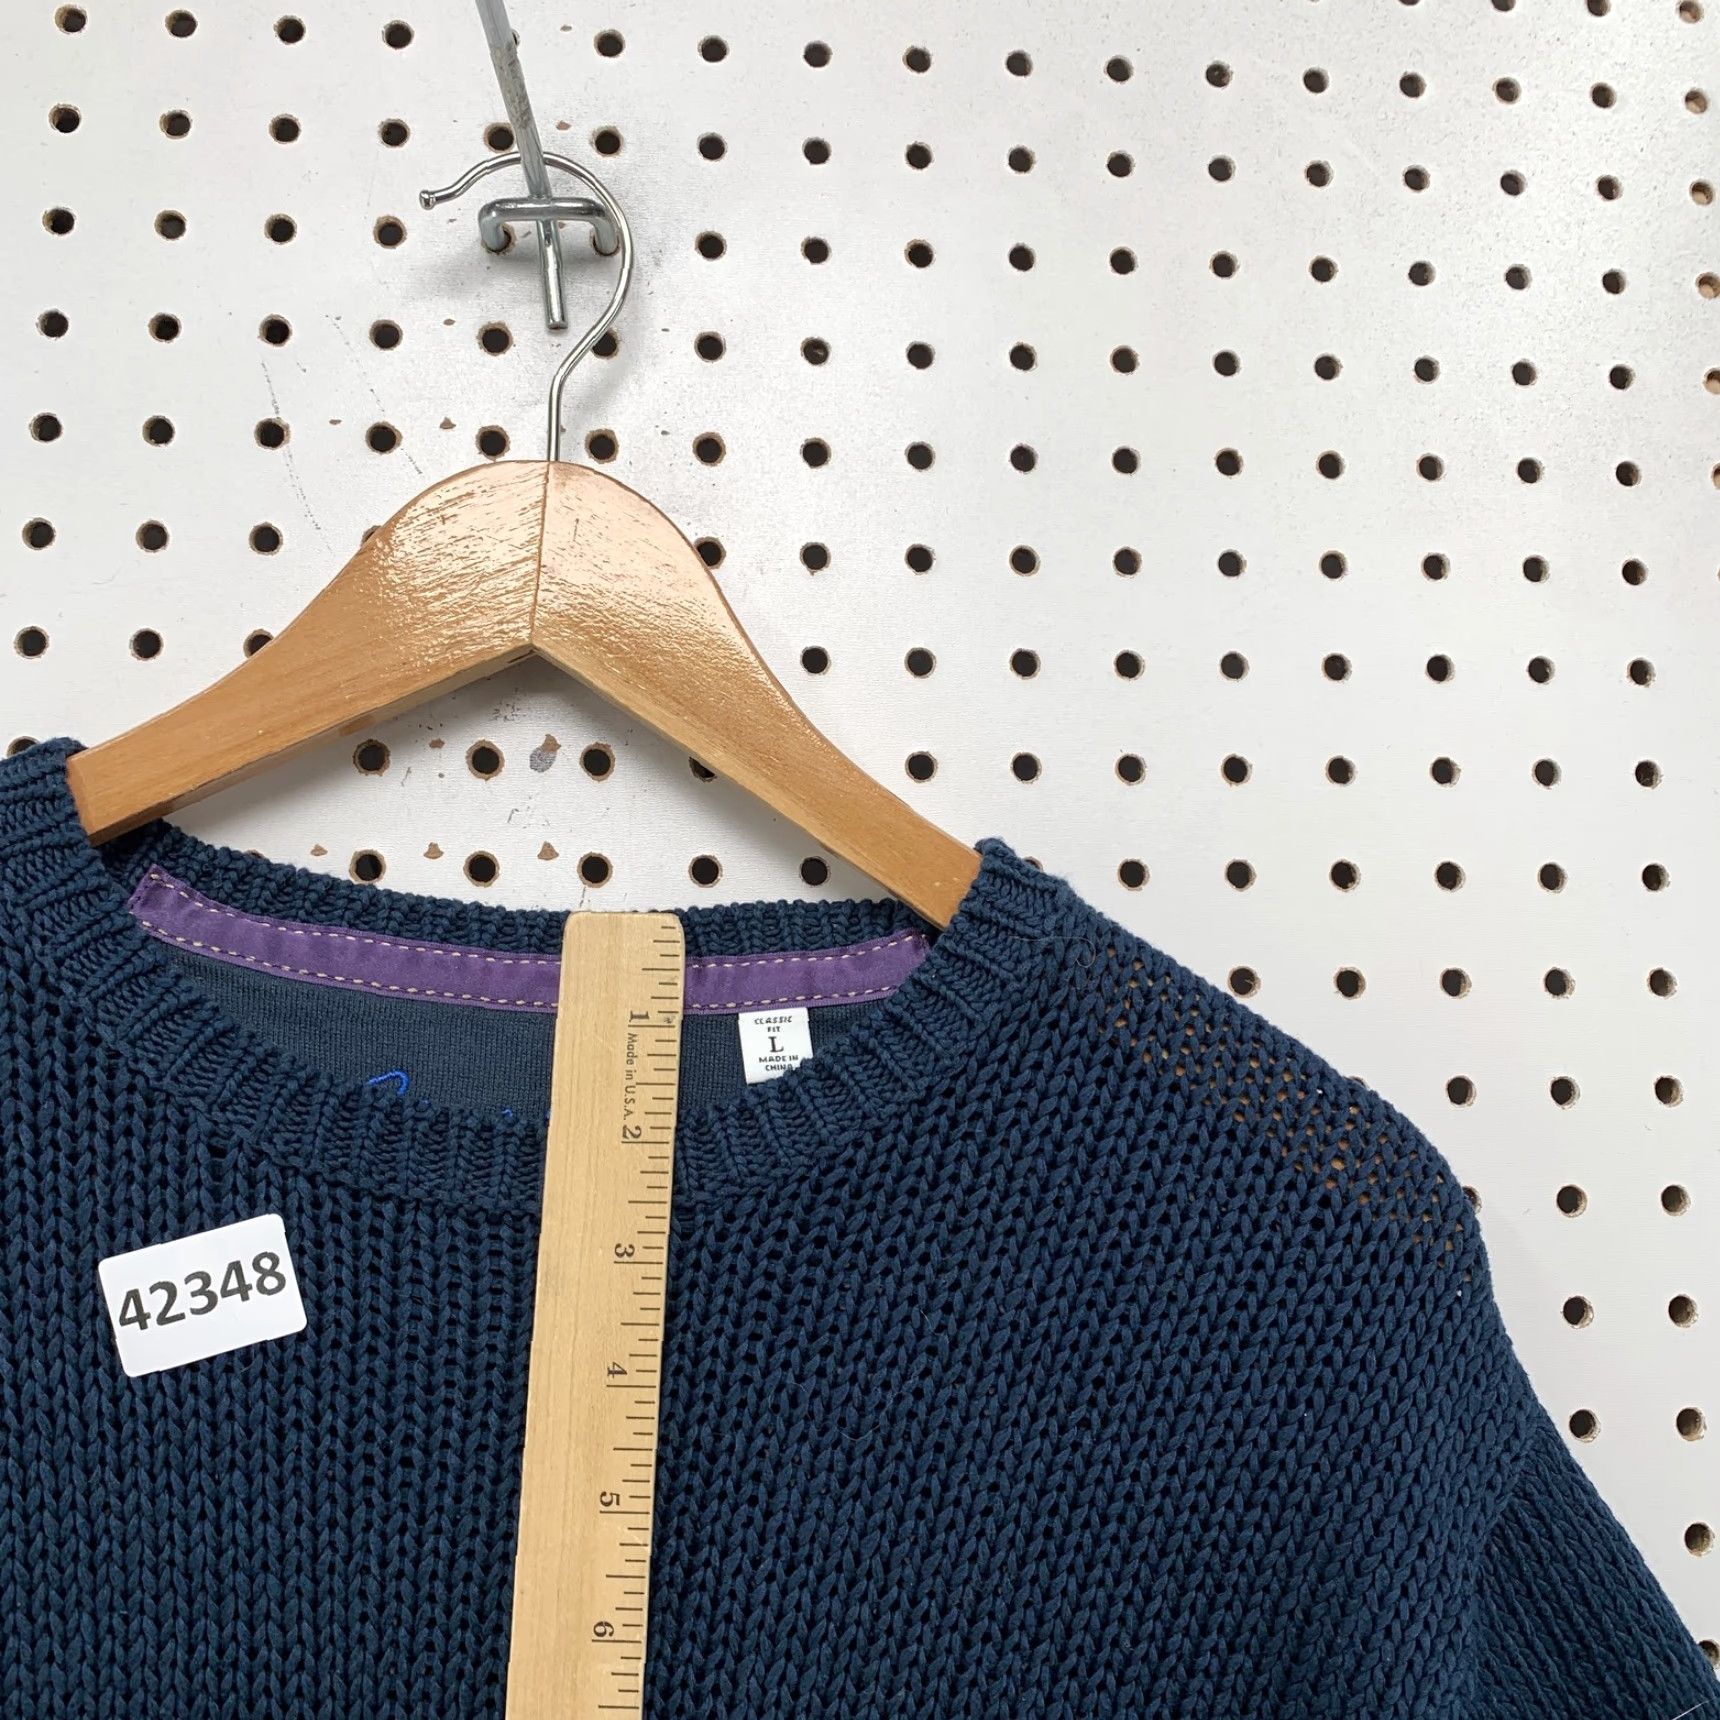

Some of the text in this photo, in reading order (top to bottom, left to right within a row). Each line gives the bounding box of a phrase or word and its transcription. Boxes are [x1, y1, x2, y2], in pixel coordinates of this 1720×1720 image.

[630, 1011, 649, 1022] 1
[754, 1016, 792, 1024] CLASSIC
[769, 1036, 784, 1052] L
[758, 1055, 787, 1063] MADE
[623, 1033, 638, 1120] Made in U.S.A.
[622, 1125, 641, 1139] 2
[614, 1243, 635, 1258] 3
[118, 1251, 287, 1331] 42348
[607, 1362, 628, 1378] 4
[600, 1491, 620, 1507] 5
[593, 1621, 614, 1638] 6
